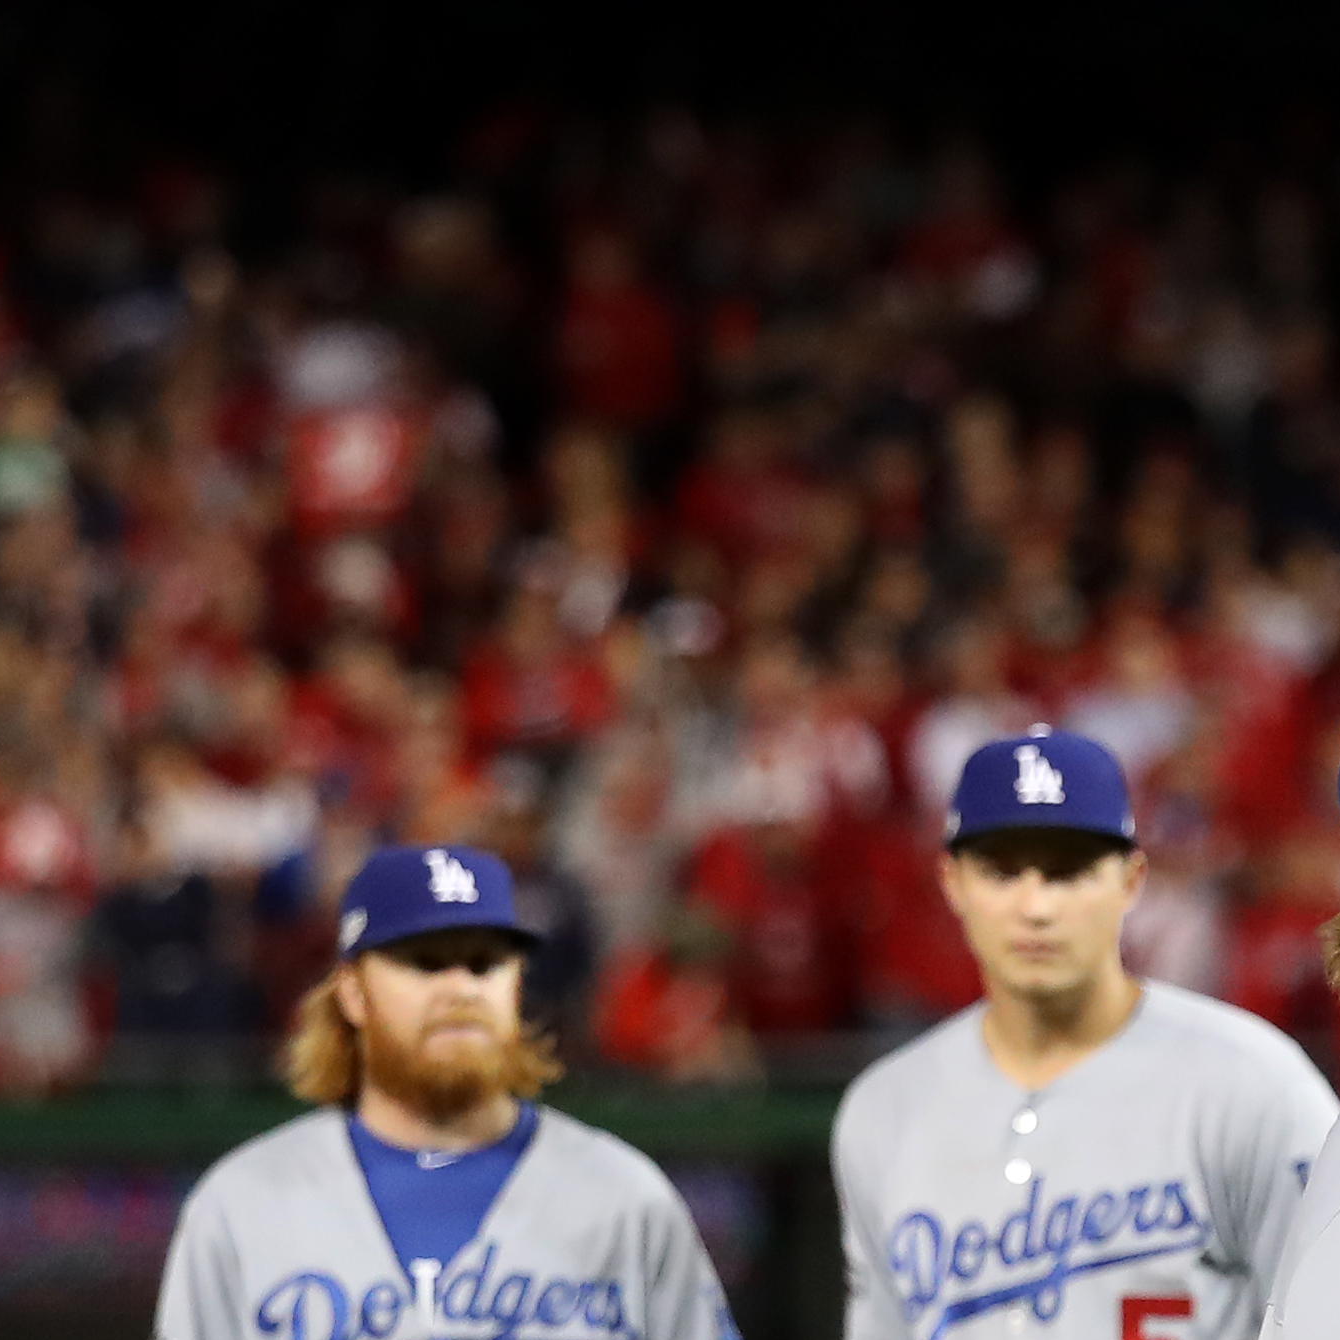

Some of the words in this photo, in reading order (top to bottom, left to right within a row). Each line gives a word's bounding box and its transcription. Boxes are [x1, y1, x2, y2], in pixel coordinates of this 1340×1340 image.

[1013, 744, 1066, 805] LA
[423, 848, 480, 903] LA
[890, 1174, 1208, 1324] Dodgers
